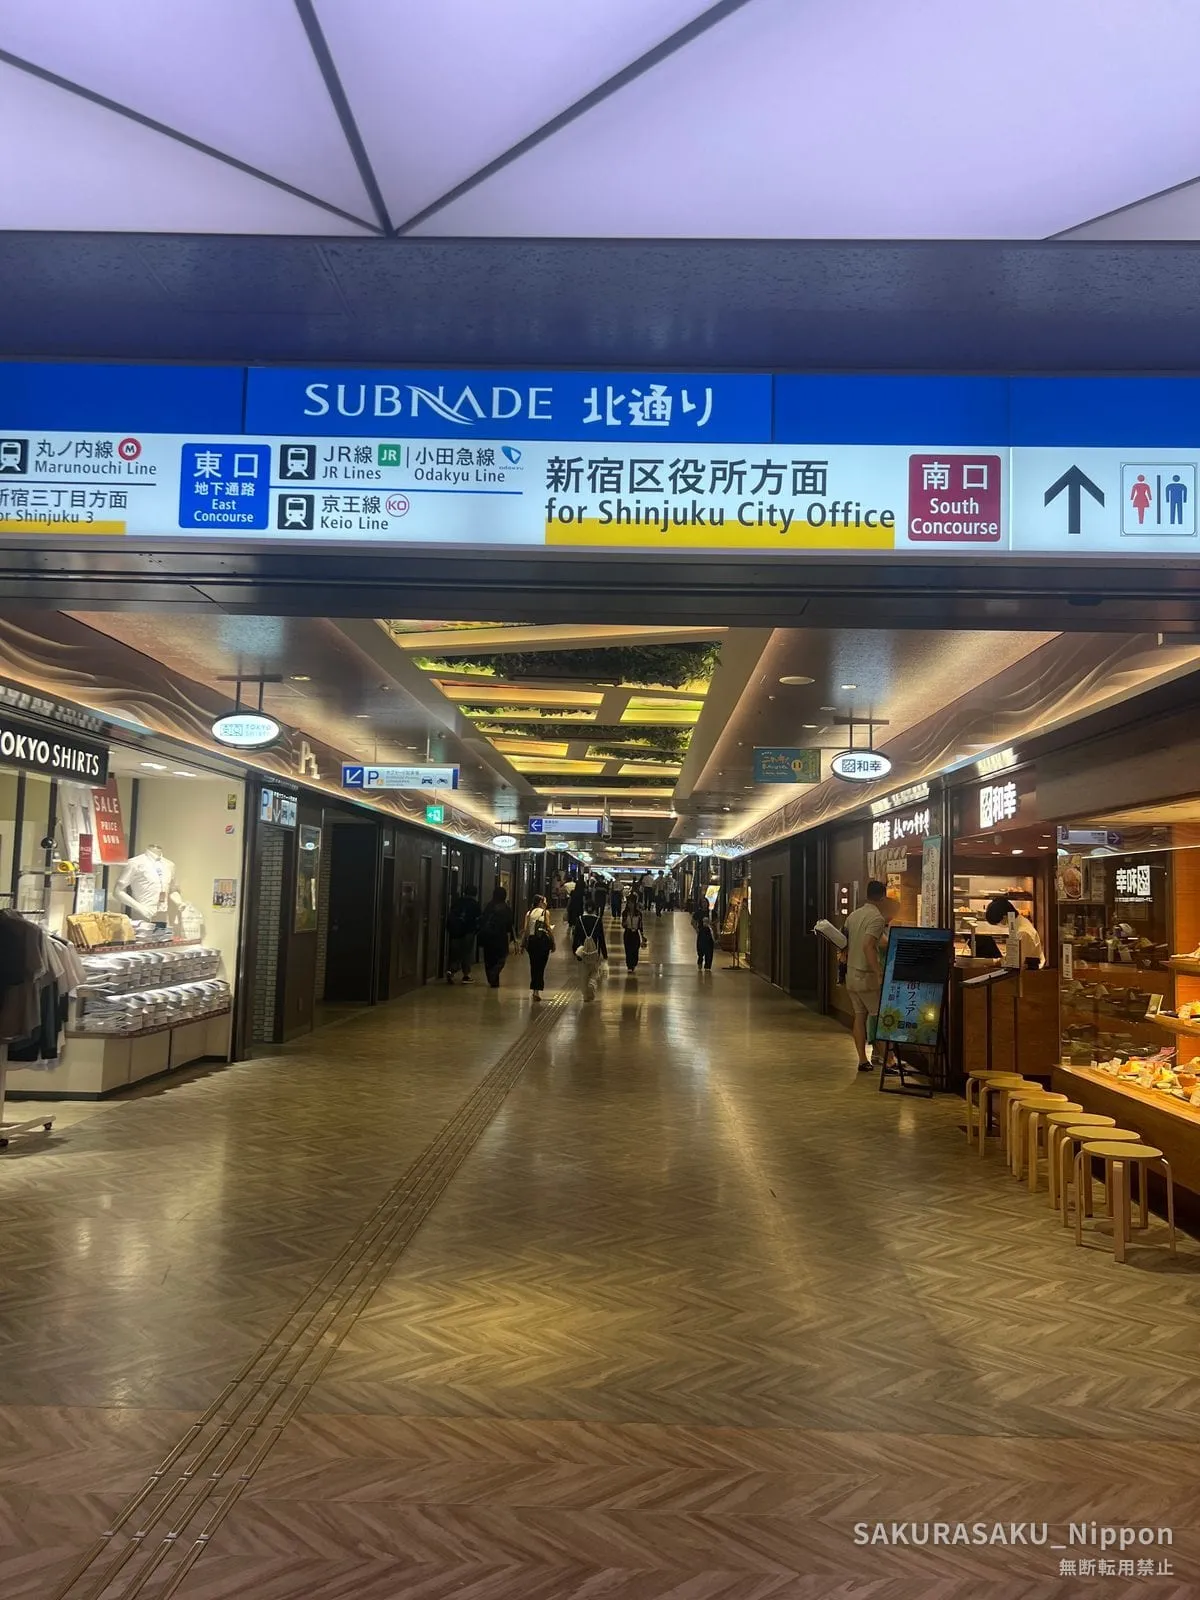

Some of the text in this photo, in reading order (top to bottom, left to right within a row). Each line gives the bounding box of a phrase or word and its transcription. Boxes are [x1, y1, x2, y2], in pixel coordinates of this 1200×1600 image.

[303, 383, 712, 427] SUBNADE 北通り
[36, 439, 114, 459] 丸ノ内線
[323, 445, 373, 465] JR線
[381, 449, 397, 461] JR
[415, 447, 495, 467] 小田急線
[35, 460, 157, 475] Marunouchi Line
[193, 450, 259, 479] 東口
[322, 466, 382, 480] JR Lines
[414, 468, 506, 485] Odakyu Line
[546, 456, 829, 497] 新宿区役所方面
[921, 461, 988, 491] 南口
[194, 481, 256, 497] 地下通路
[212, 498, 237, 511] East
[321, 494, 381, 515] 京王線
[929, 497, 979, 515] South
[16, 509, 79, 526] Shinjuku
[86, 511, 94, 524] 3
[193, 510, 254, 523] Concourse
[320, 516, 389, 530] Keio Line
[545, 498, 896, 534] for Shinjuku City Office
[911, 517, 998, 535] Concourse
[0, 729, 99, 776] OKYO SHIRTS
[94, 795, 120, 814] SALE
[100, 820, 118, 832] PRICE
